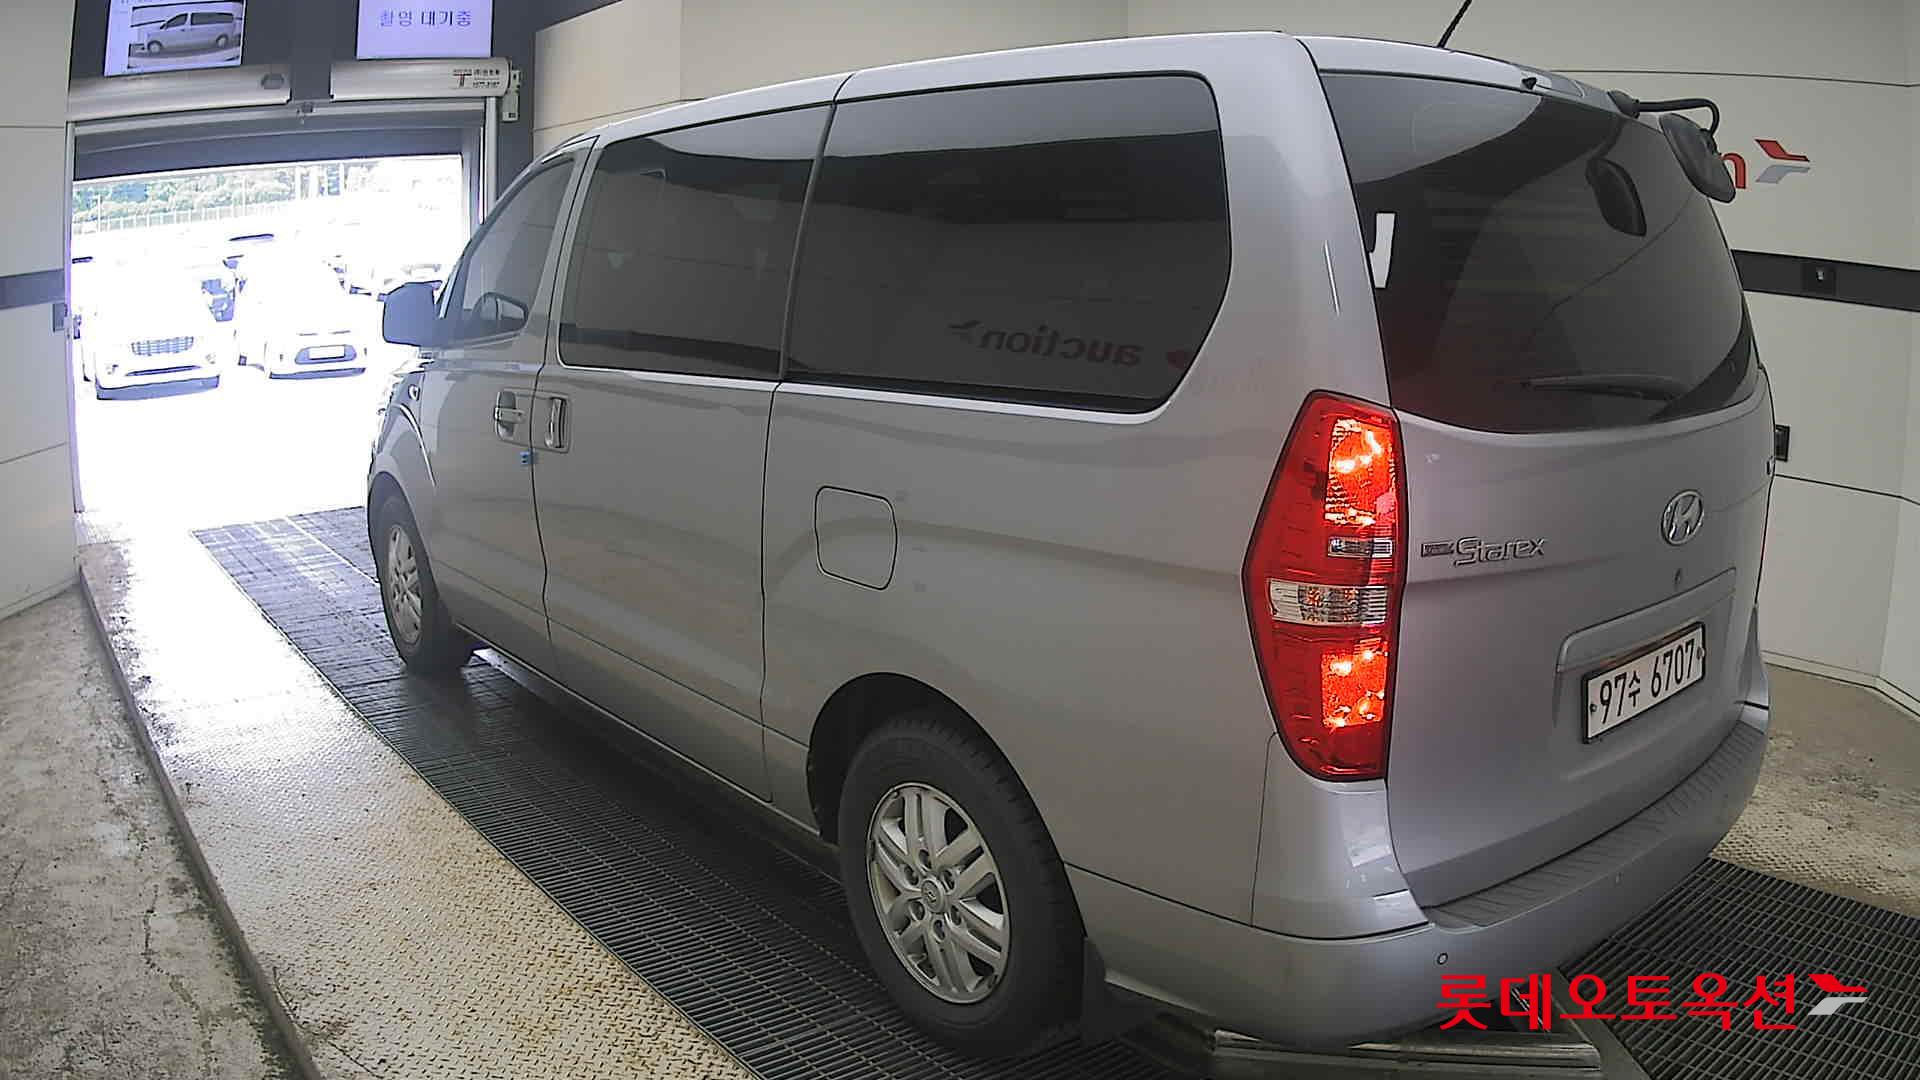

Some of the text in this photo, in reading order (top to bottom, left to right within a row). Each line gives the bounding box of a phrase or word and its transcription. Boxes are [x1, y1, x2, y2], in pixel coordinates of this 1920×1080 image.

[421, 9, 472, 28] 대기중
[1453, 535, 1546, 568] Starex
[1599, 638, 1696, 725] 97수 6707
